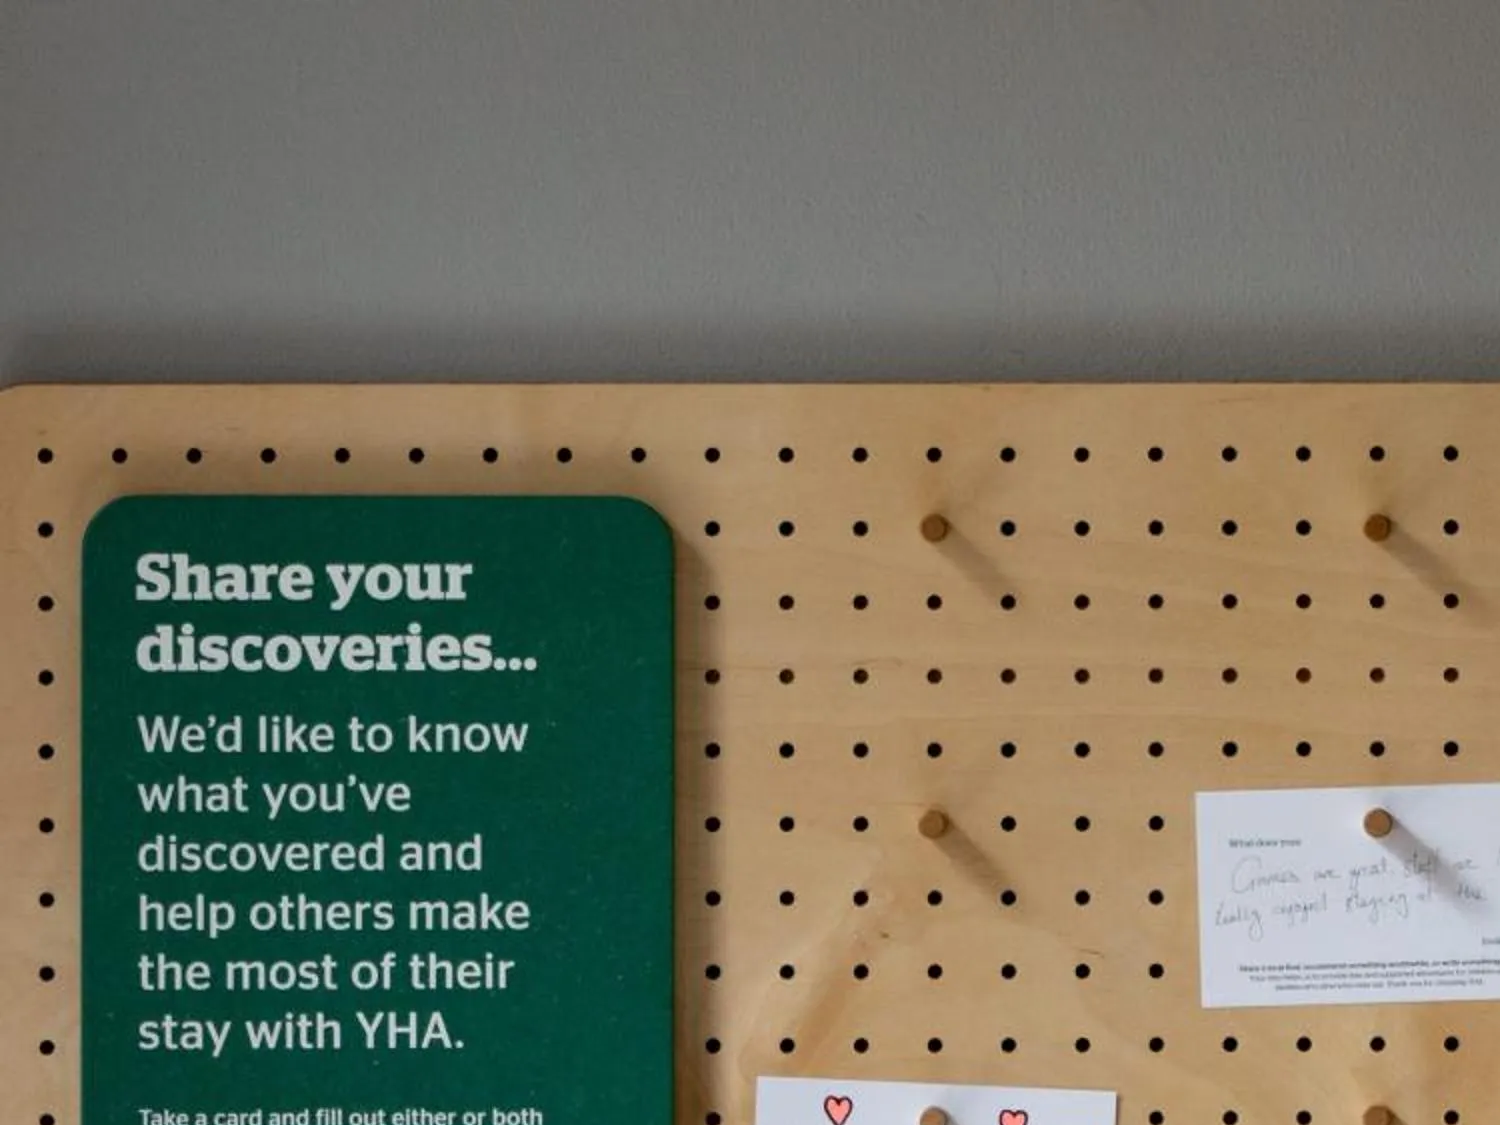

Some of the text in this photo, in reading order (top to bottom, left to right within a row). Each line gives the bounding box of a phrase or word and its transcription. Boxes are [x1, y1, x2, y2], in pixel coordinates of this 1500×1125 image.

[135, 552, 473, 611] Share your
[135, 621, 538, 673] discoveries...
[137, 714, 529, 753] We'd like to know
[137, 774, 411, 820] what you've
[138, 833, 482, 872] discovered and
[139, 892, 531, 939] help others make
[137, 951, 515, 991] the most of their
[138, 1011, 464, 1058] stay with YHA.
